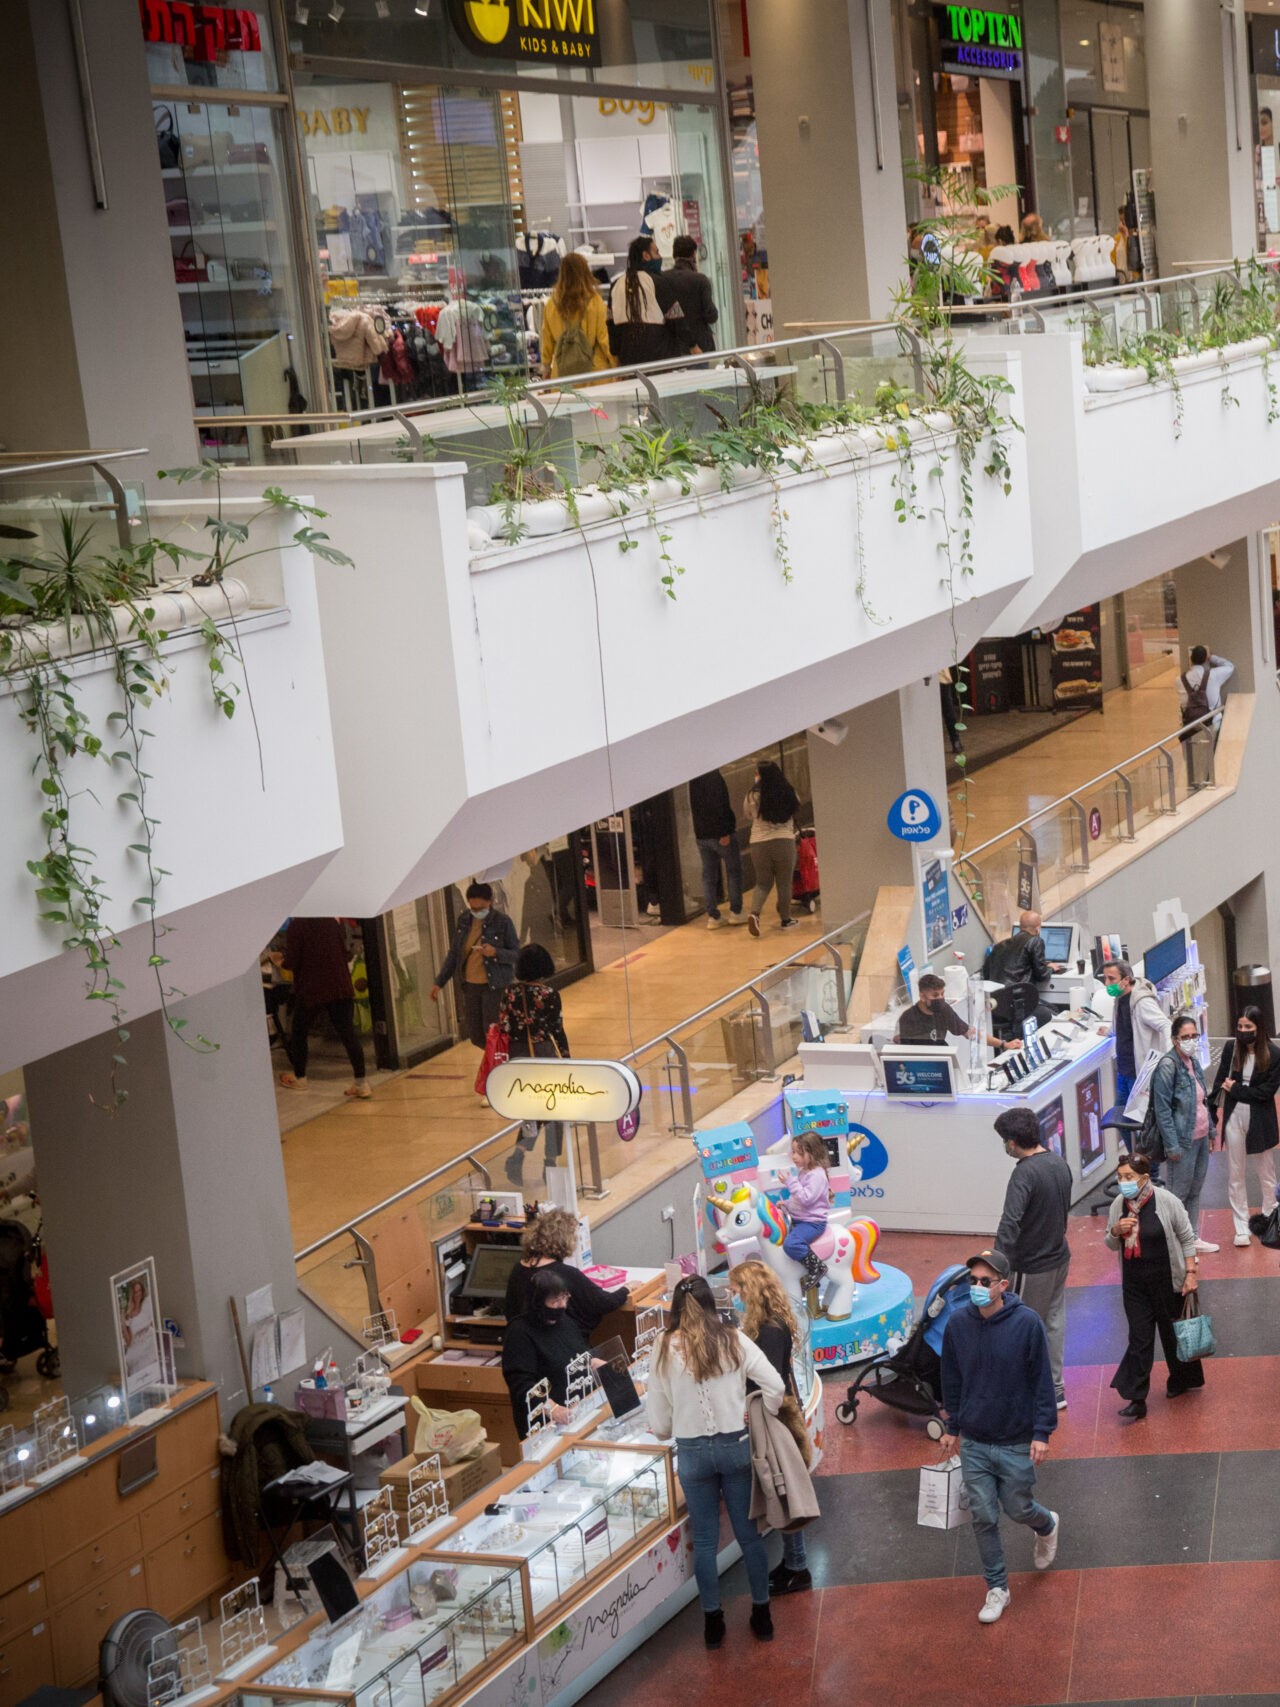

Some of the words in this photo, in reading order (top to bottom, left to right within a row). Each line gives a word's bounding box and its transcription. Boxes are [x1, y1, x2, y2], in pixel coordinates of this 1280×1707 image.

[520, 37, 547, 53] KIDS
[551, 40, 559, 54] &
[562, 41, 591, 58] BABY
[902, 826, 931, 836] פלאפון
[895, 1071, 916, 1085] 5G
[709, 1153, 752, 1171] UNICORN
[850, 1184, 885, 1198] פלאפ
[813, 1340, 862, 1362] OUSEL
